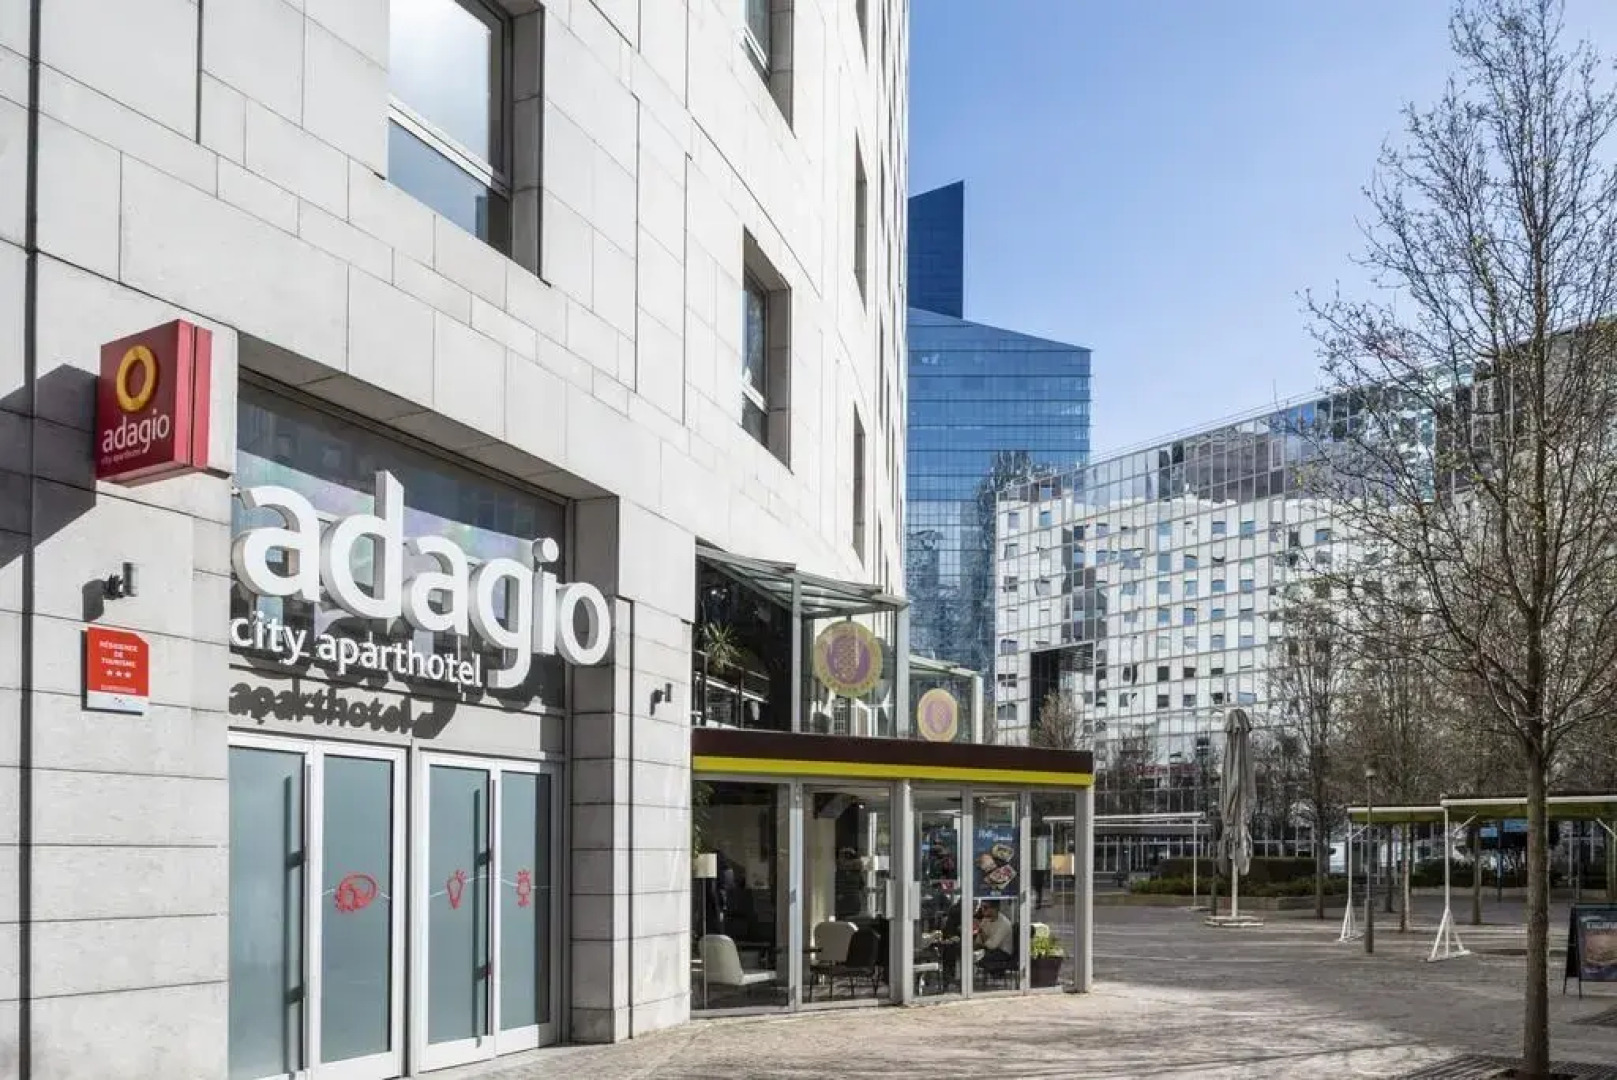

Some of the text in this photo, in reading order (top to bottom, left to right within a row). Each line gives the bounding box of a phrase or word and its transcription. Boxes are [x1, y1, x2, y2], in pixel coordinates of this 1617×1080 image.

[102, 408, 170, 453] adagio
[231, 470, 611, 689] adagio
[230, 610, 483, 688] city aparthotel
